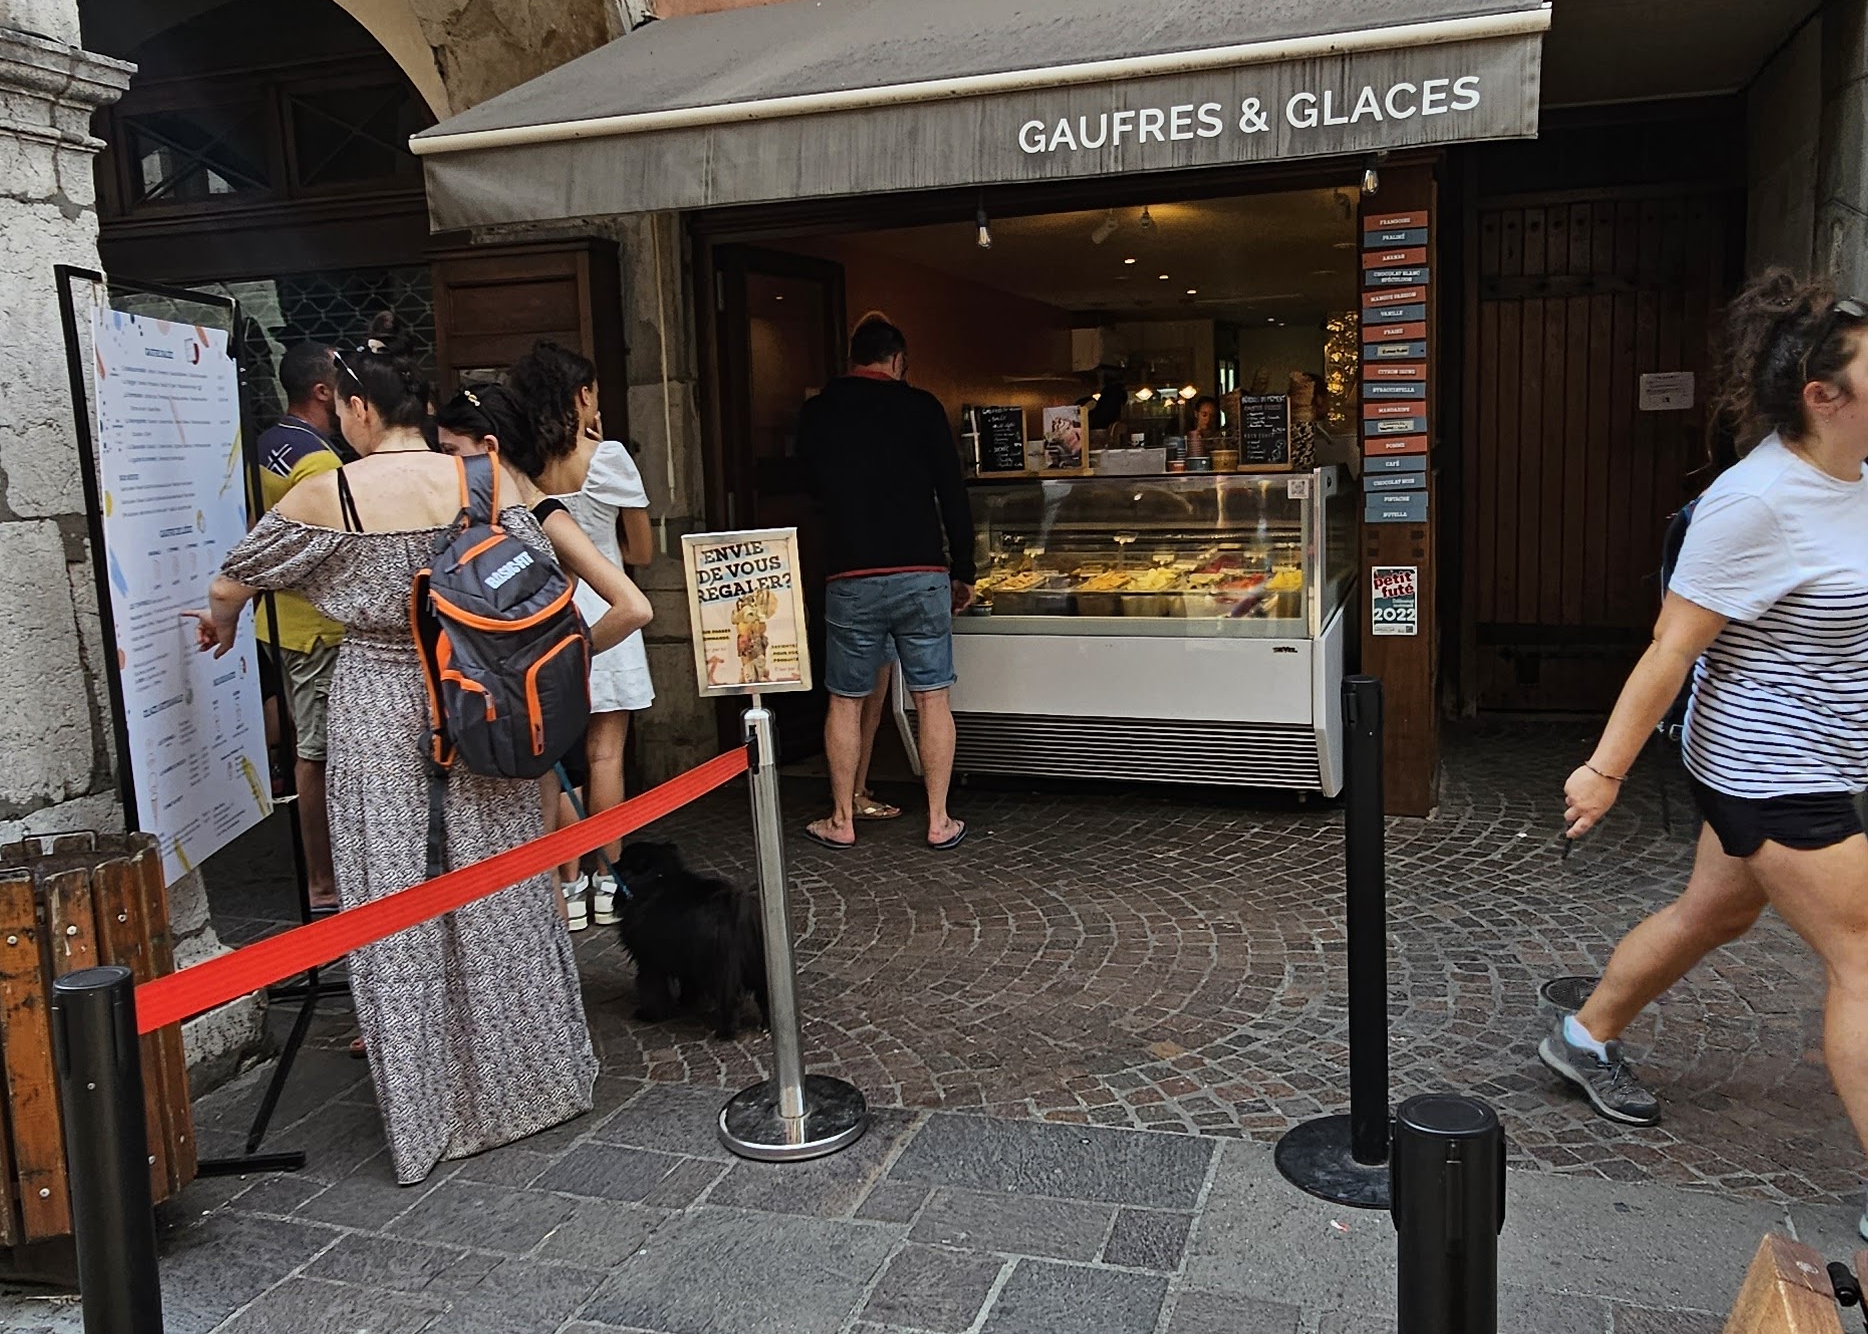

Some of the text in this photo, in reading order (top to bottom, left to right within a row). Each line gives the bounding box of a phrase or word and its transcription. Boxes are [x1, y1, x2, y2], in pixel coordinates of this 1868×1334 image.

[1018, 75, 1481, 154] GAUFRES & GLACES
[1380, 309, 1404, 317] VANILLE
[701, 540, 764, 565] ENVIE
[696, 555, 782, 585] DE VOUS
[1373, 571, 1413, 590] petit
[1381, 583, 1414, 598] futé
[1373, 607, 1416, 622] 2022
